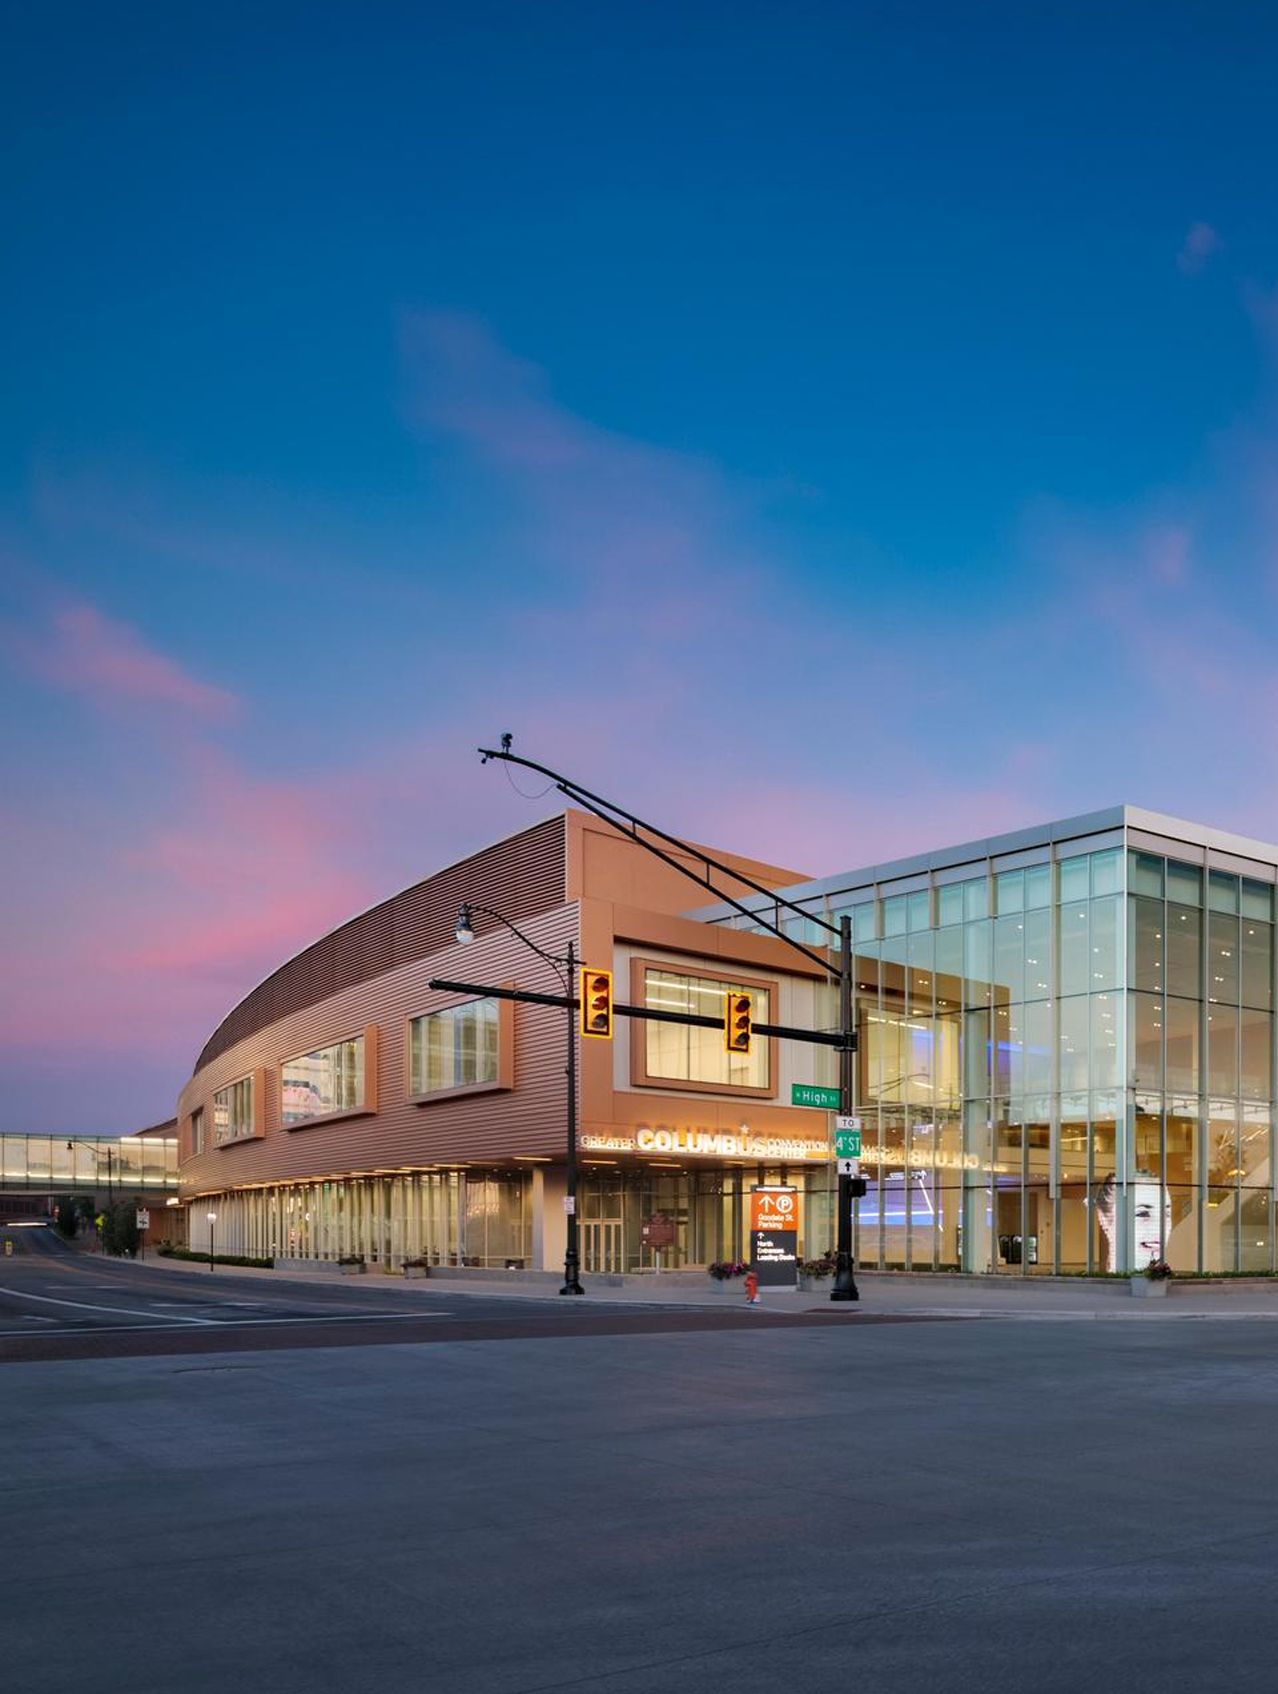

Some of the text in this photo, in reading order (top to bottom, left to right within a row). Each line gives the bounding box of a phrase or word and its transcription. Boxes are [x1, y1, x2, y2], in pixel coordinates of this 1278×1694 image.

[802, 1091, 828, 1105] High
[842, 1119, 854, 1127] TO
[580, 1129, 829, 1158] GREATER COLUMBUS CONVENTION
[848, 1137, 860, 1152] ST
[758, 1221, 783, 1230] Parking
[757, 1254, 779, 1262] Loading
